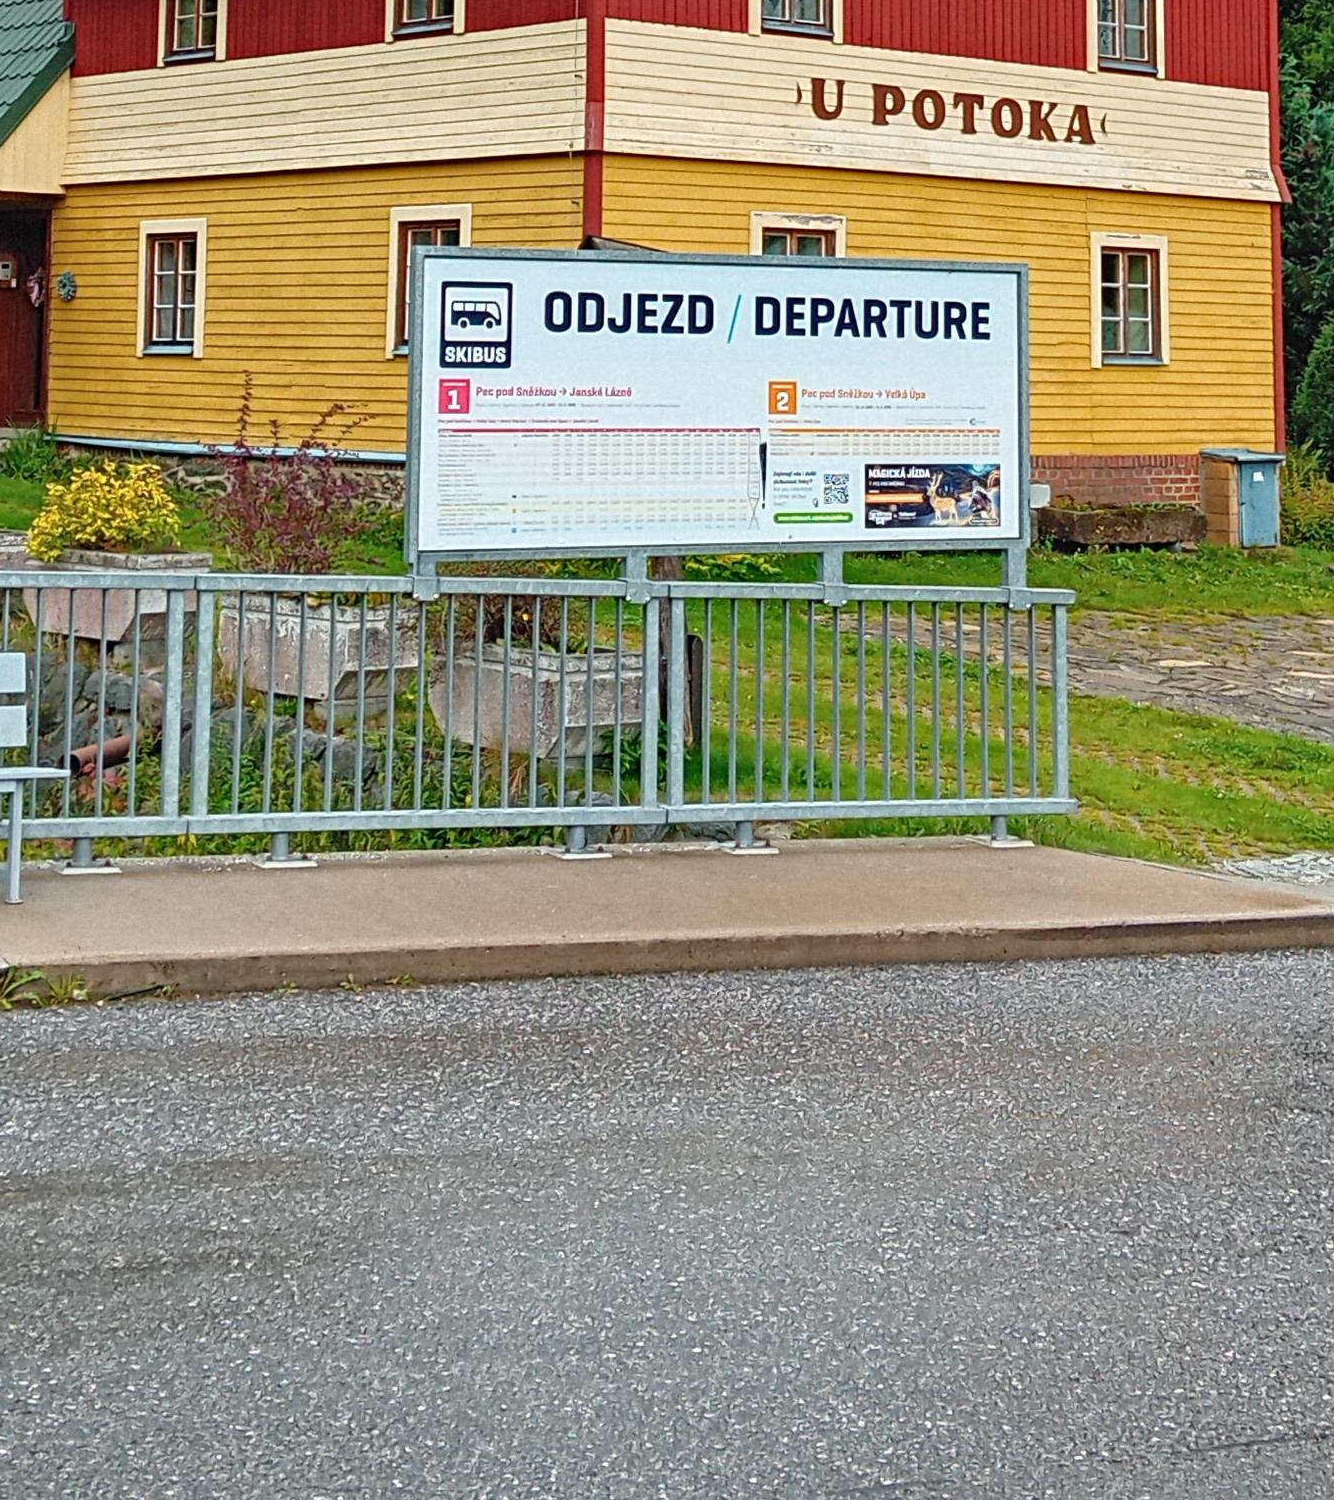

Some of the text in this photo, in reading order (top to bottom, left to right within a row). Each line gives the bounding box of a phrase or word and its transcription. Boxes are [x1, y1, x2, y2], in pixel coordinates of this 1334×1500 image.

[810, 77, 1096, 145] U POTOKA
[544, 291, 714, 335] ODJEZD
[755, 295, 991, 341] DEPARTURE
[444, 346, 507, 363] SKIBUS
[447, 389, 461, 410] 1
[475, 386, 632, 399] Pec pod Sněžkou Janské Lázně
[776, 391, 790, 412] 2
[801, 387, 926, 400] Pec pod Sněžkou Velká Úpa
[868, 466, 931, 479] MAGICKÁ JÍZDA
